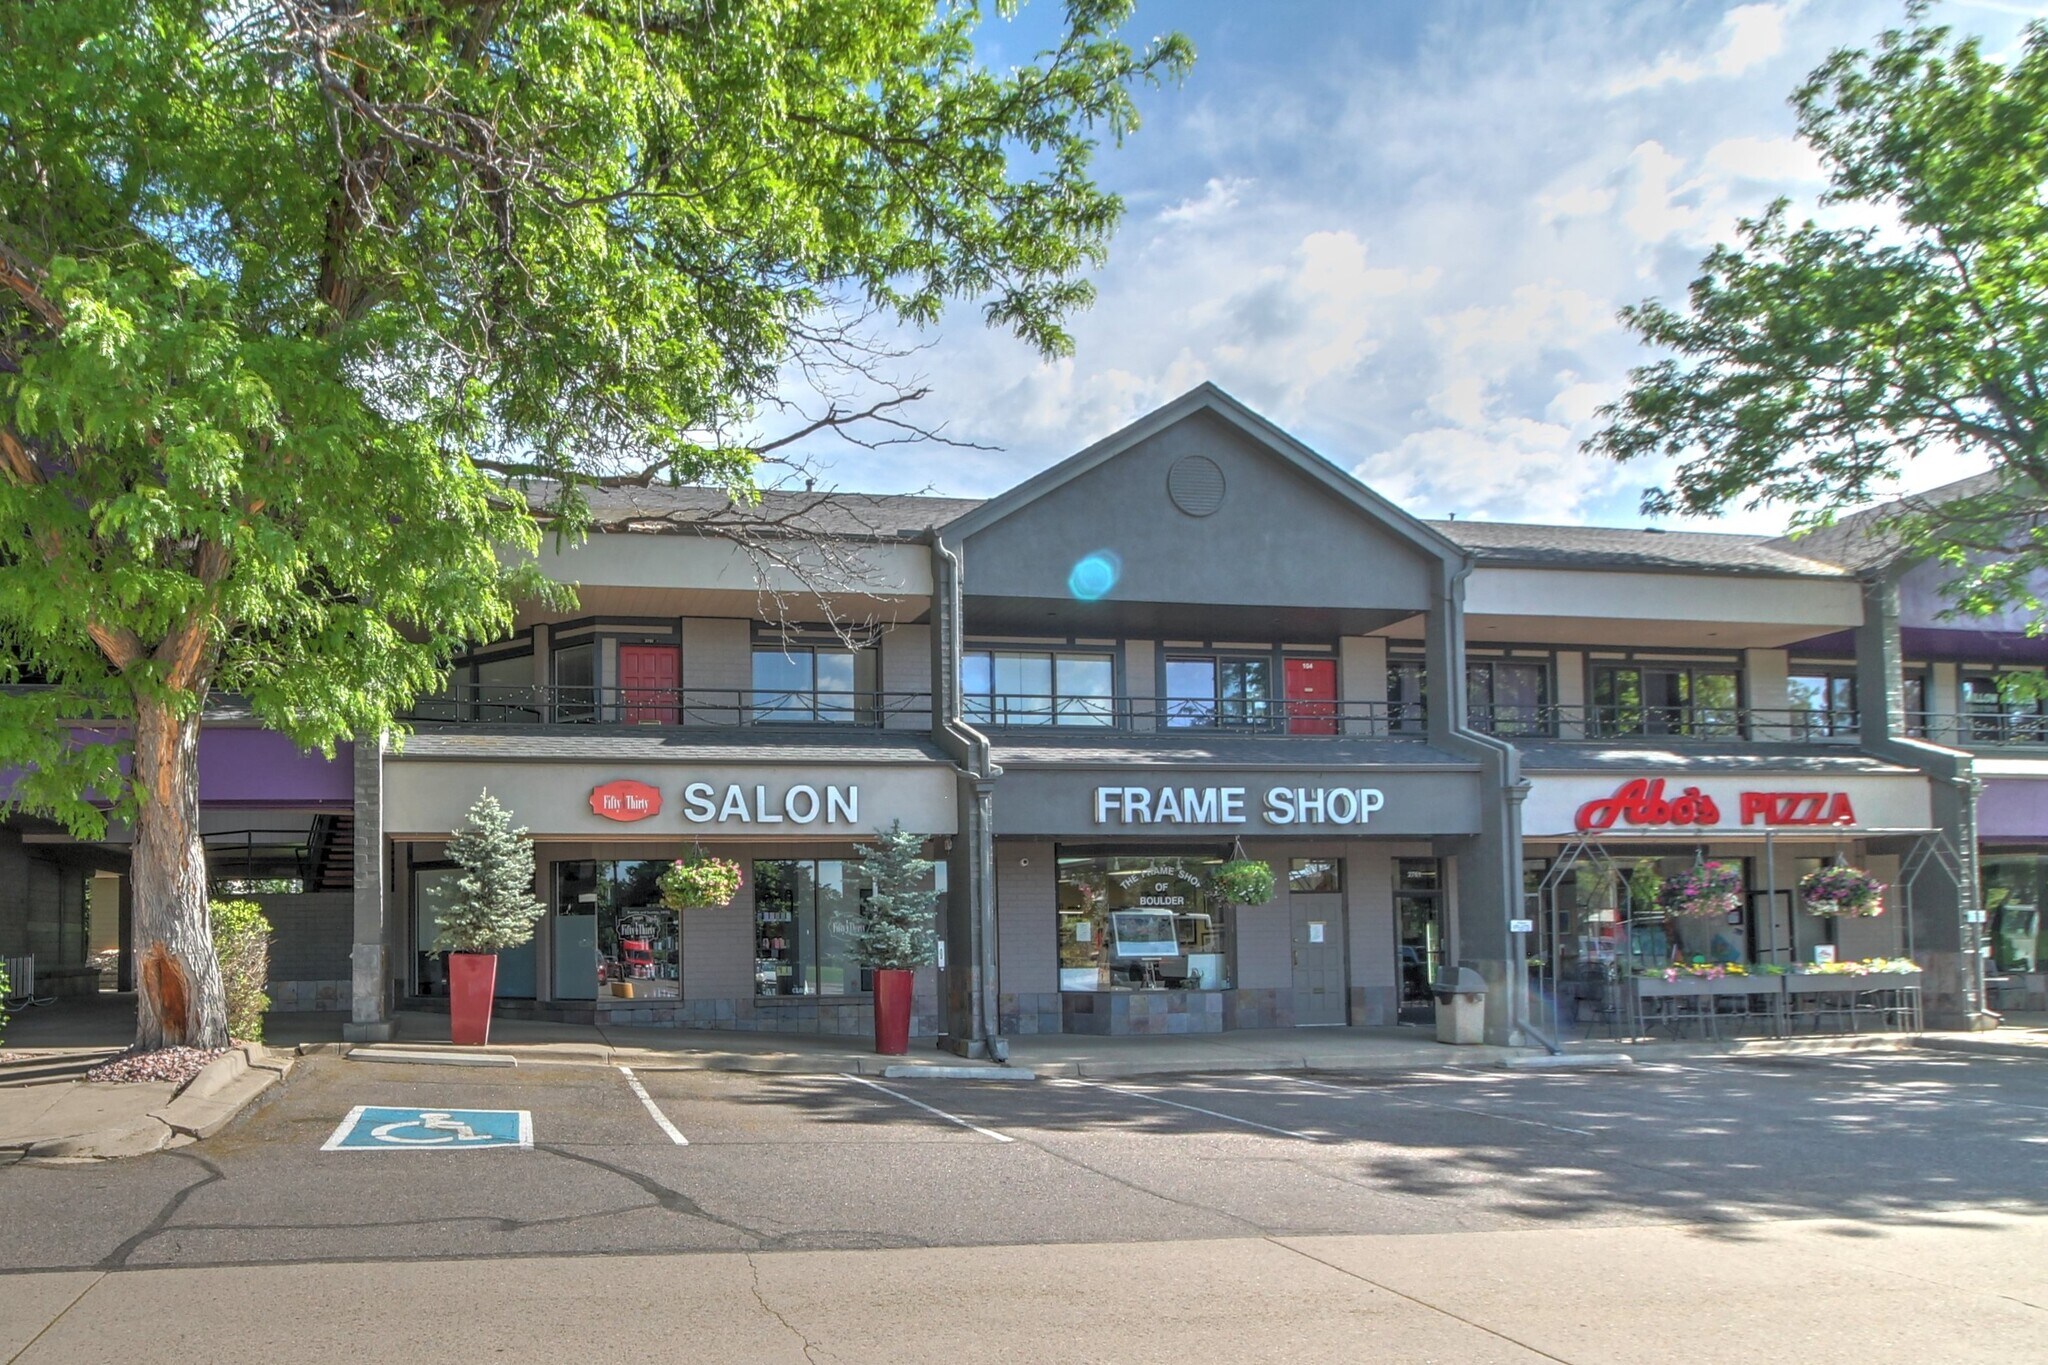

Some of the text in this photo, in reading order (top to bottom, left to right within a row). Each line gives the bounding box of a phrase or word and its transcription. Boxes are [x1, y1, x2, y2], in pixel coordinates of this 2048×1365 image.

[603, 795, 649, 813] Fifty Thirty
[683, 782, 858, 823] SALON
[1095, 786, 1384, 825] FRAME SHOP
[1574, 778, 1856, 834] Abo's PIZZA
[1120, 874, 1139, 890] THE
[1141, 867, 1175, 878] FRAME
[1155, 883, 1169, 892] OF
[1140, 896, 1184, 906] BOULDER
[621, 923, 656, 938] Fifty Thirty
